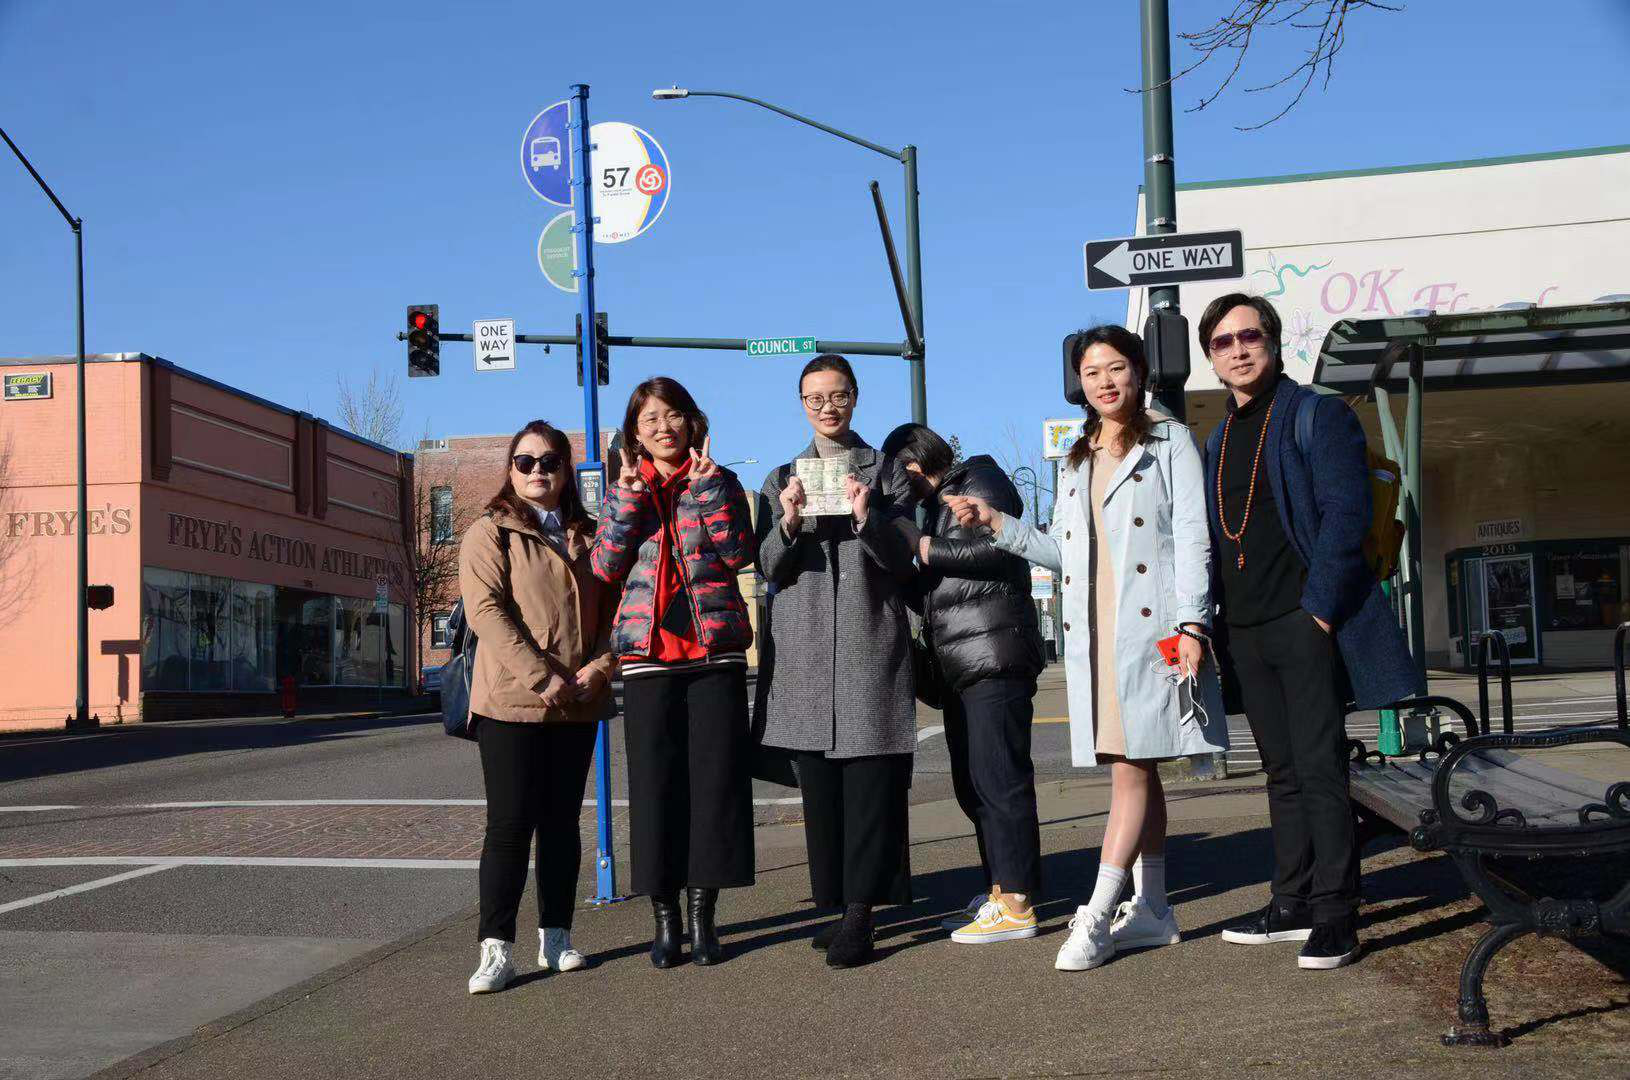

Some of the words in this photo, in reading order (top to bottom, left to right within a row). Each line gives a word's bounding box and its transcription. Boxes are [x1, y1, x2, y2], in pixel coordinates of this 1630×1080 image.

[603, 167, 630, 188] 57
[1133, 250, 1174, 271] ONE
[1183, 246, 1225, 267] WAY
[1320, 268, 1404, 317] OK
[480, 325, 507, 337] ONE
[480, 339, 508, 351] WAY
[749, 340, 800, 354] COUNCIL
[803, 340, 813, 350] ST
[5, 502, 132, 538] FRYE'S
[1478, 520, 1520, 537] ANTIQUES
[167, 512, 242, 557] FRYE'S
[247, 530, 317, 570] ACTION
[321, 545, 403, 586] ATHLETICS
[1481, 543, 1516, 556] 2019
